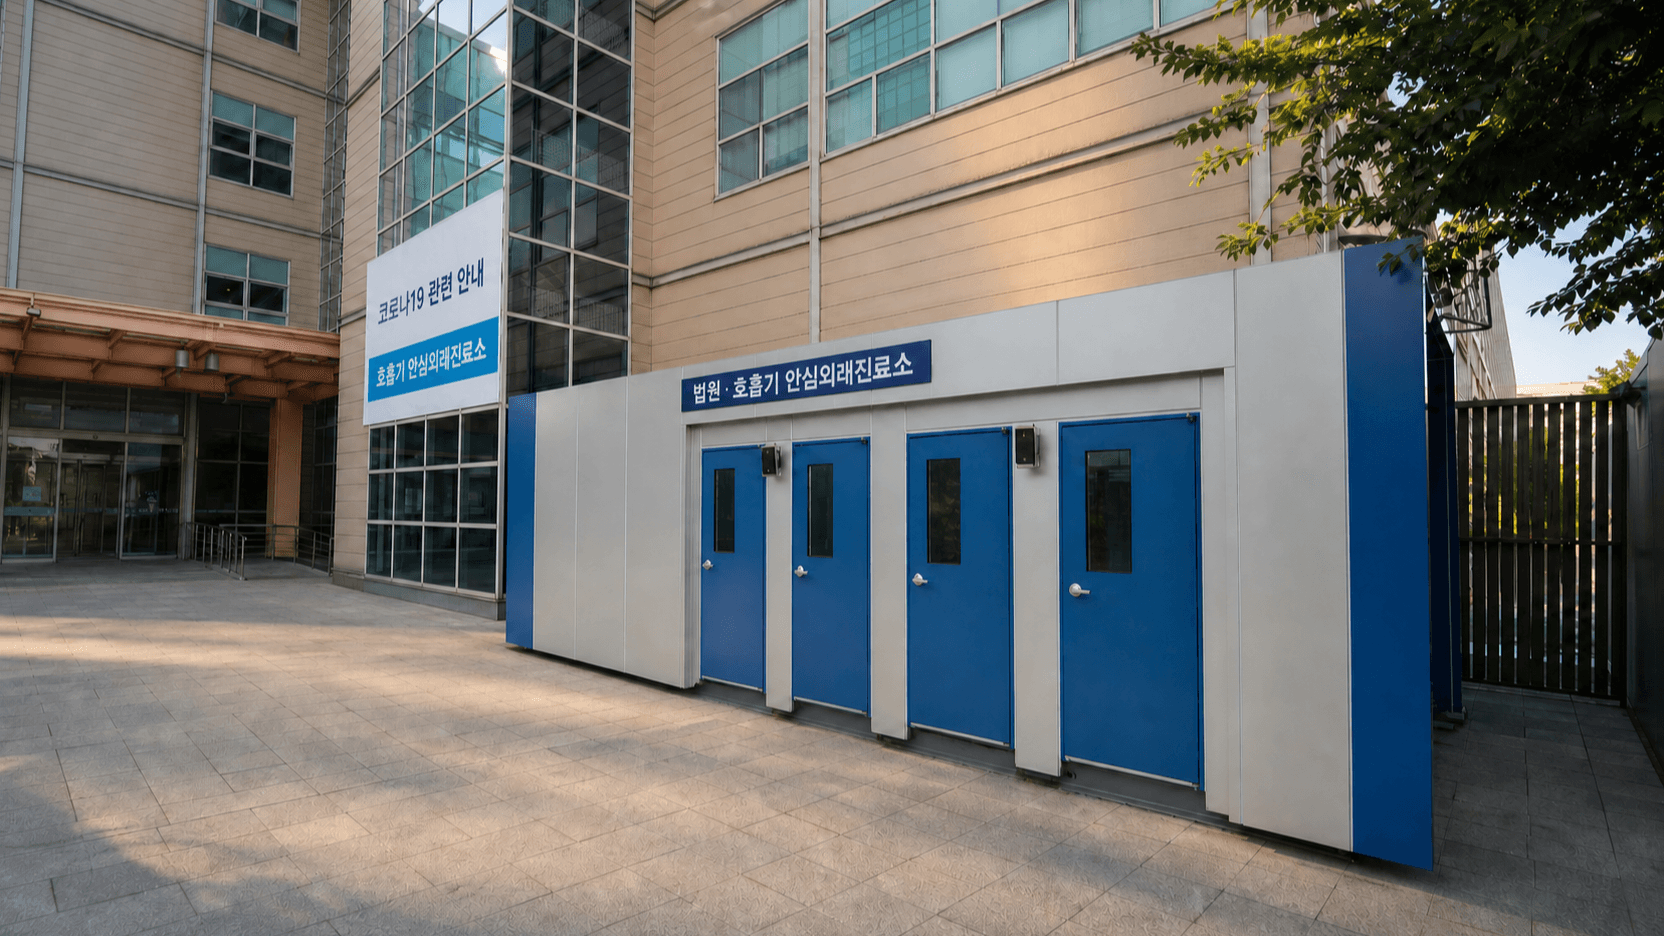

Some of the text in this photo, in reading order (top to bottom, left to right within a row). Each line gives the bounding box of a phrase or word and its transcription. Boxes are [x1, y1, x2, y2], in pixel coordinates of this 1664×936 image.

[377, 257, 485, 325] 코로나19 관련 안내
[376, 338, 488, 388] 호흡기 안심외래진료소
[693, 379, 721, 405] 법원
[732, 371, 780, 399] 호흡기
[785, 352, 915, 393] 안심외래진료소
